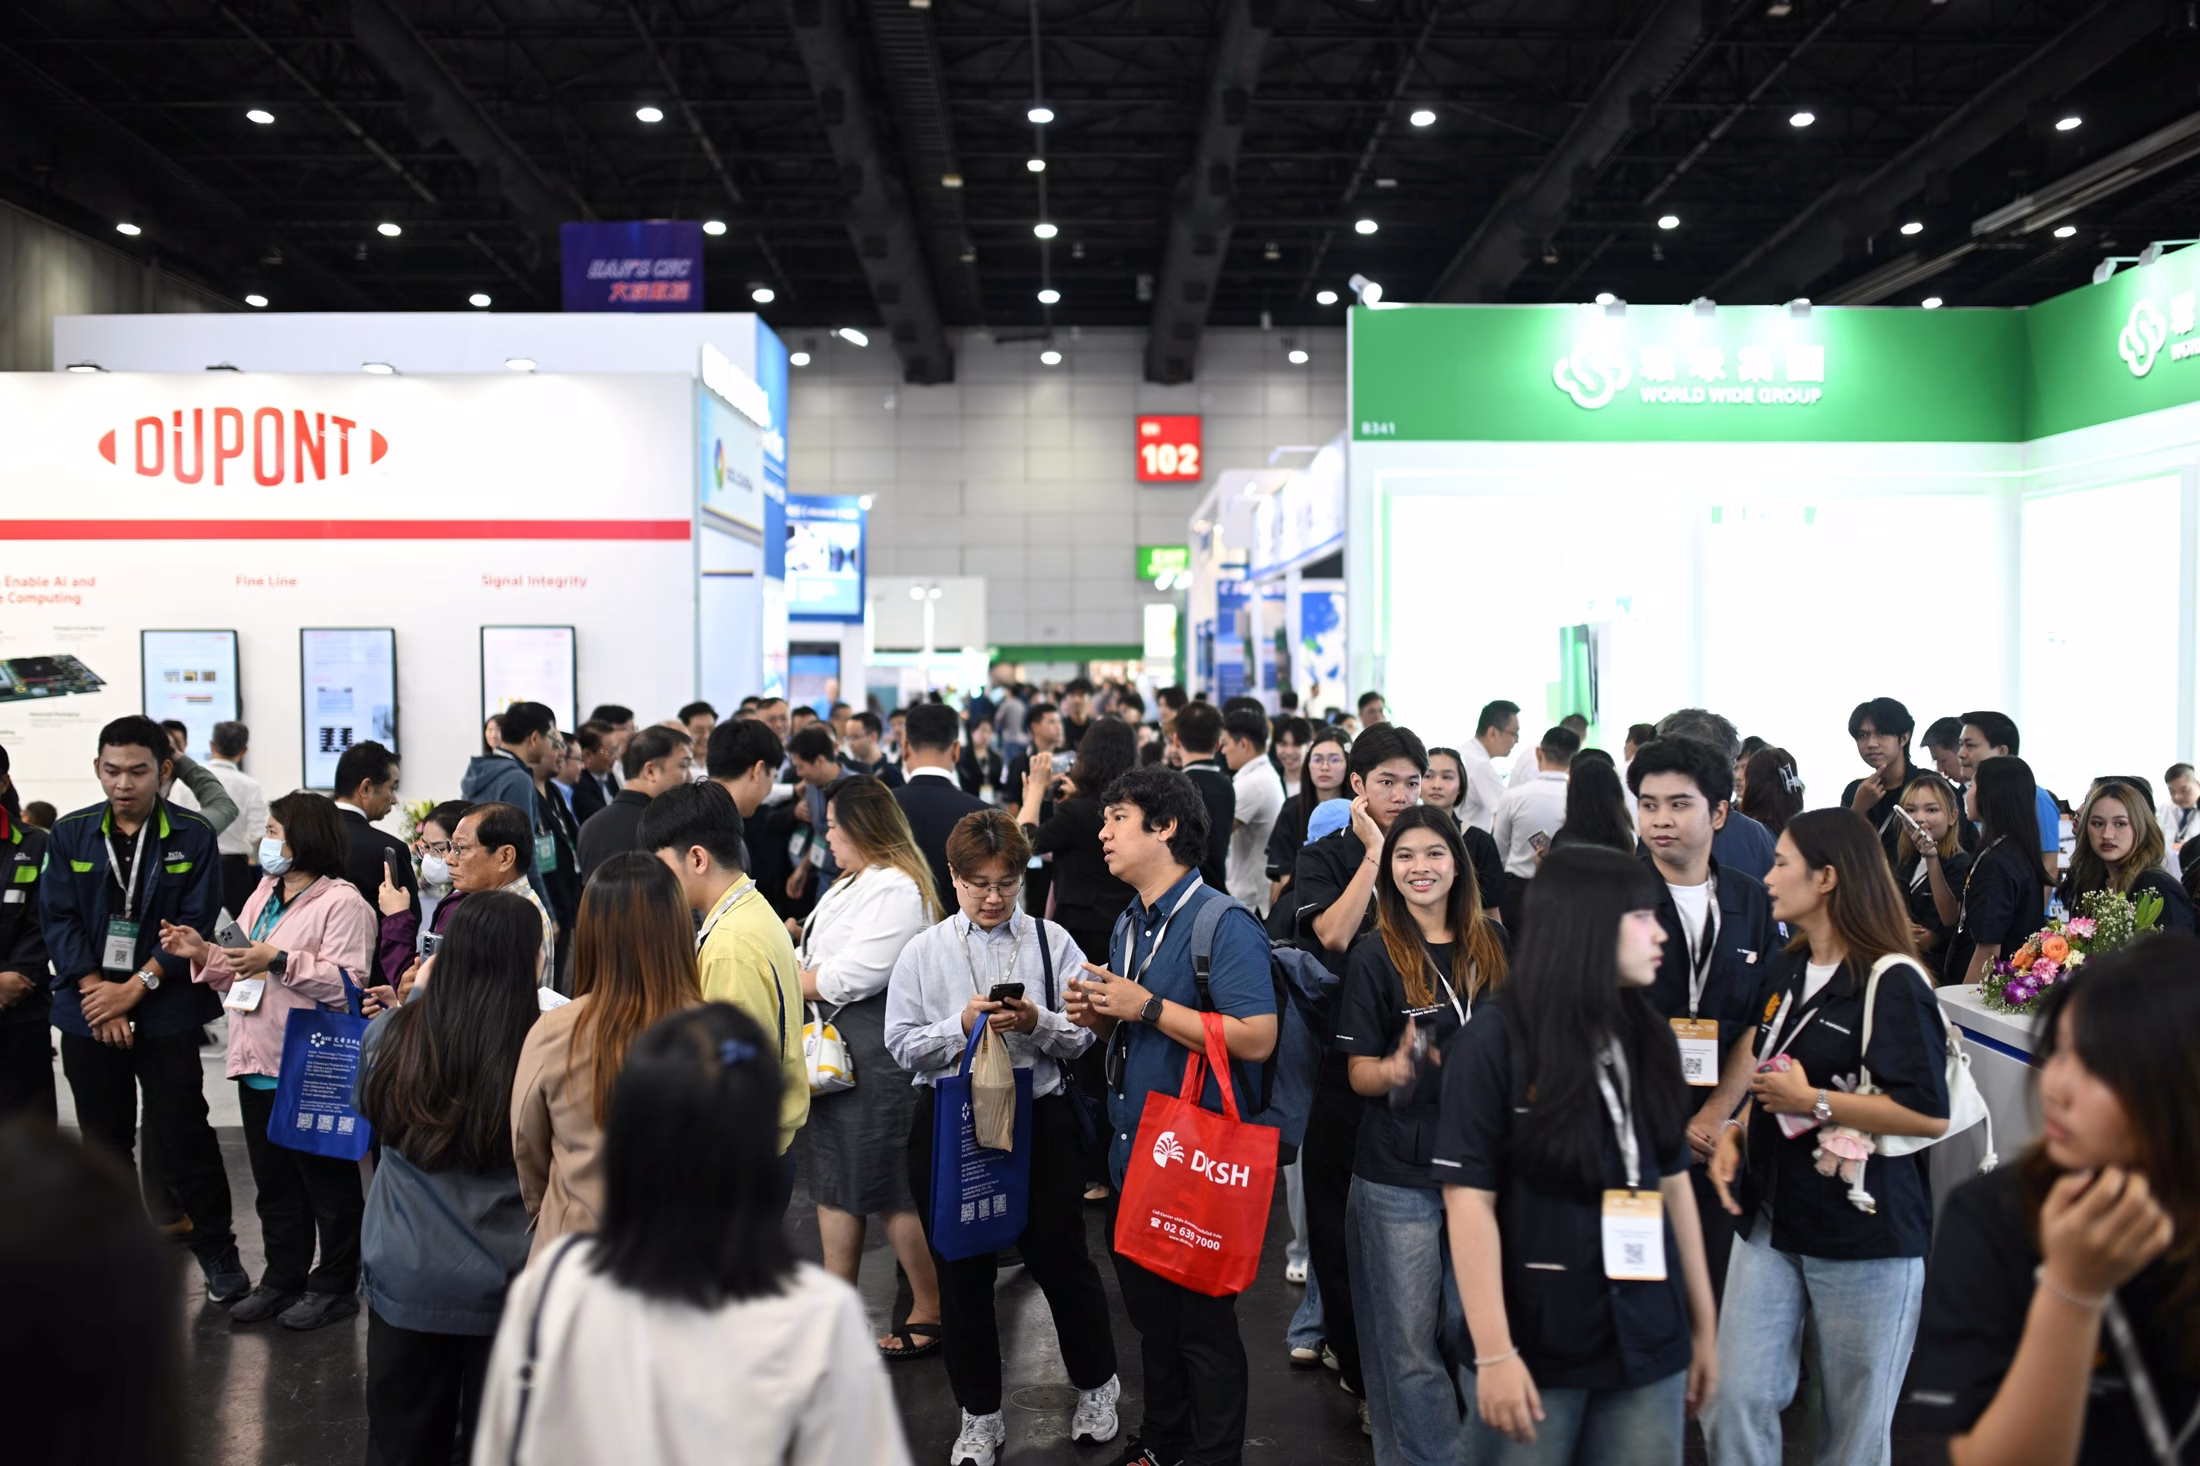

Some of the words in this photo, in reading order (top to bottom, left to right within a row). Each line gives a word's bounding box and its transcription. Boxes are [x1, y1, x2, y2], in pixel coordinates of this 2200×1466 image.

[1640, 387, 1705, 404] WORLD
[1709, 387, 1755, 404] WIDE
[1758, 387, 1822, 405] GROUP
[1361, 422, 1395, 435] B341
[135, 406, 356, 486] DUPONT
[1141, 443, 1199, 475] 102
[4, 575, 49, 587] Enable
[72, 576, 96, 587] and
[235, 575, 263, 587] Fine
[268, 575, 297, 587] Line
[481, 574, 523, 589] Signal
[528, 574, 587, 589] Integrity
[8, 592, 81, 606] Computing
[1190, 1149, 1250, 1187] DKSH
[1163, 1221, 1177, 1234] 02
[1179, 1227, 1195, 1241] 639
[1195, 1234, 1221, 1251] 7000
